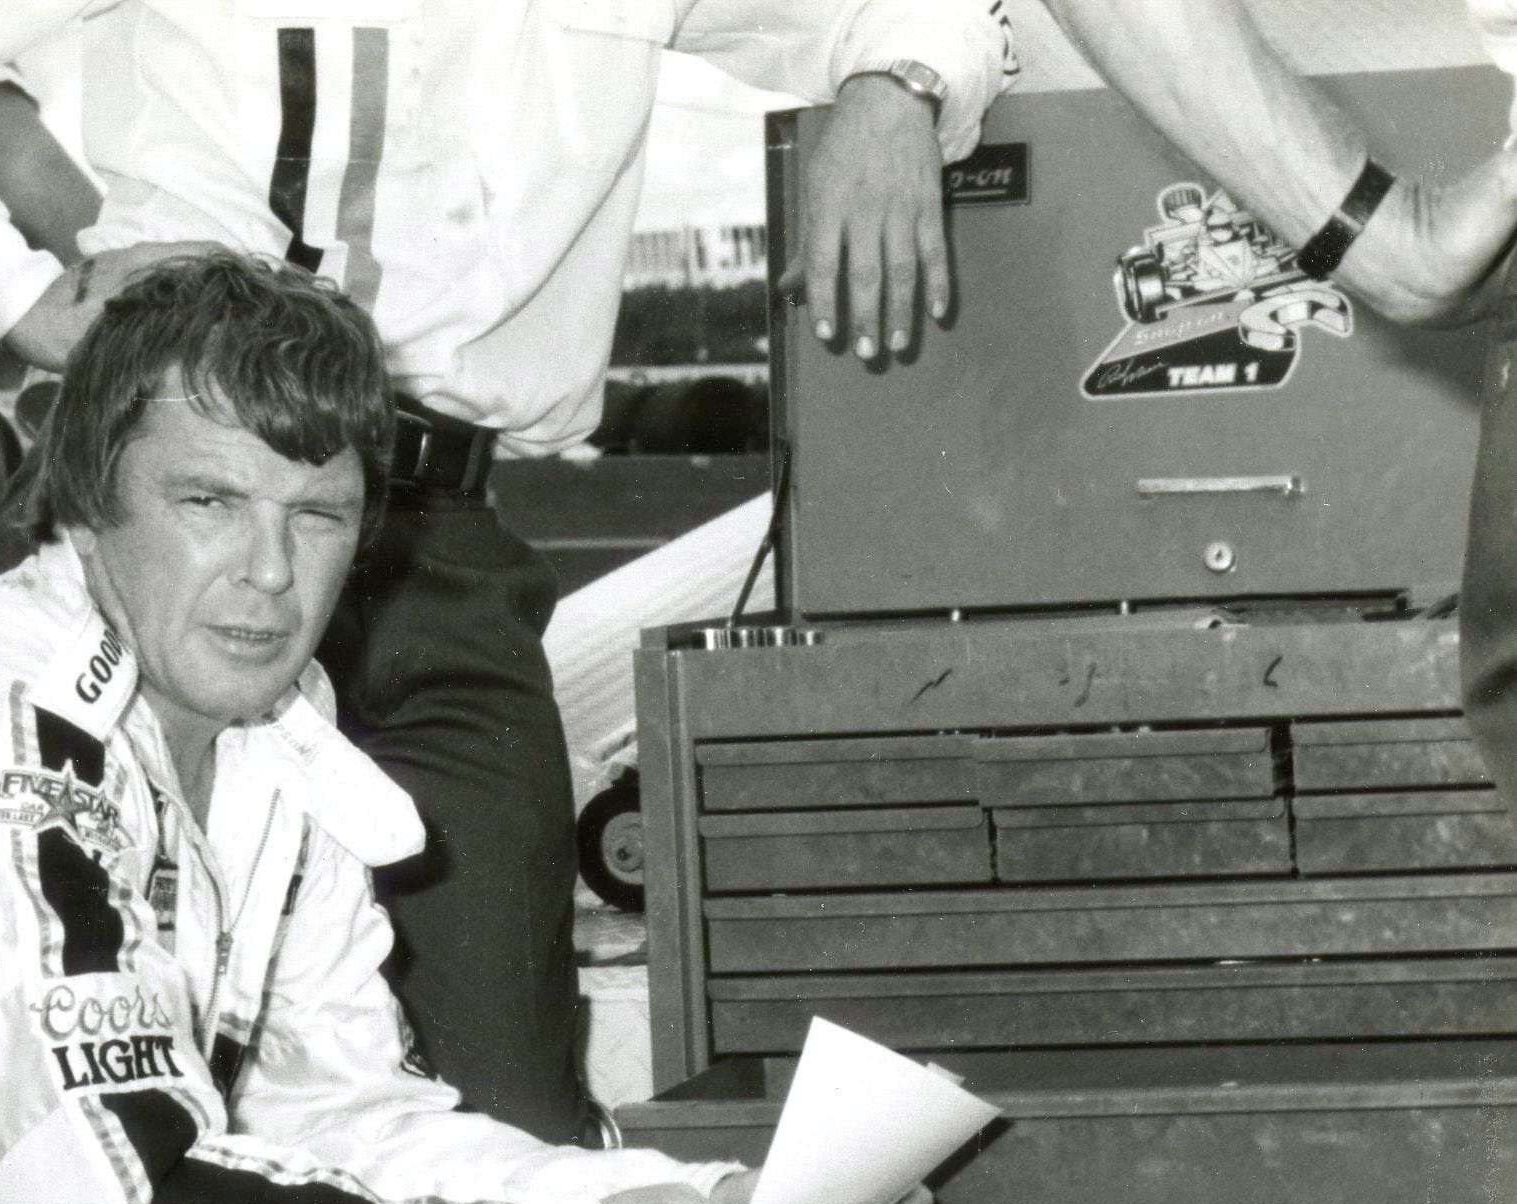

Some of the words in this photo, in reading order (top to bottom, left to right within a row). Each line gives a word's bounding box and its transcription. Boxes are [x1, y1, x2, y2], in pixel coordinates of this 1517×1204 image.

[1166, 361, 1237, 387] TEAM
[1244, 361, 1260, 383] 1
[3, 772, 64, 800] FIVE
[29, 984, 174, 1041] Coors
[52, 1035, 185, 1090] LIGHT
